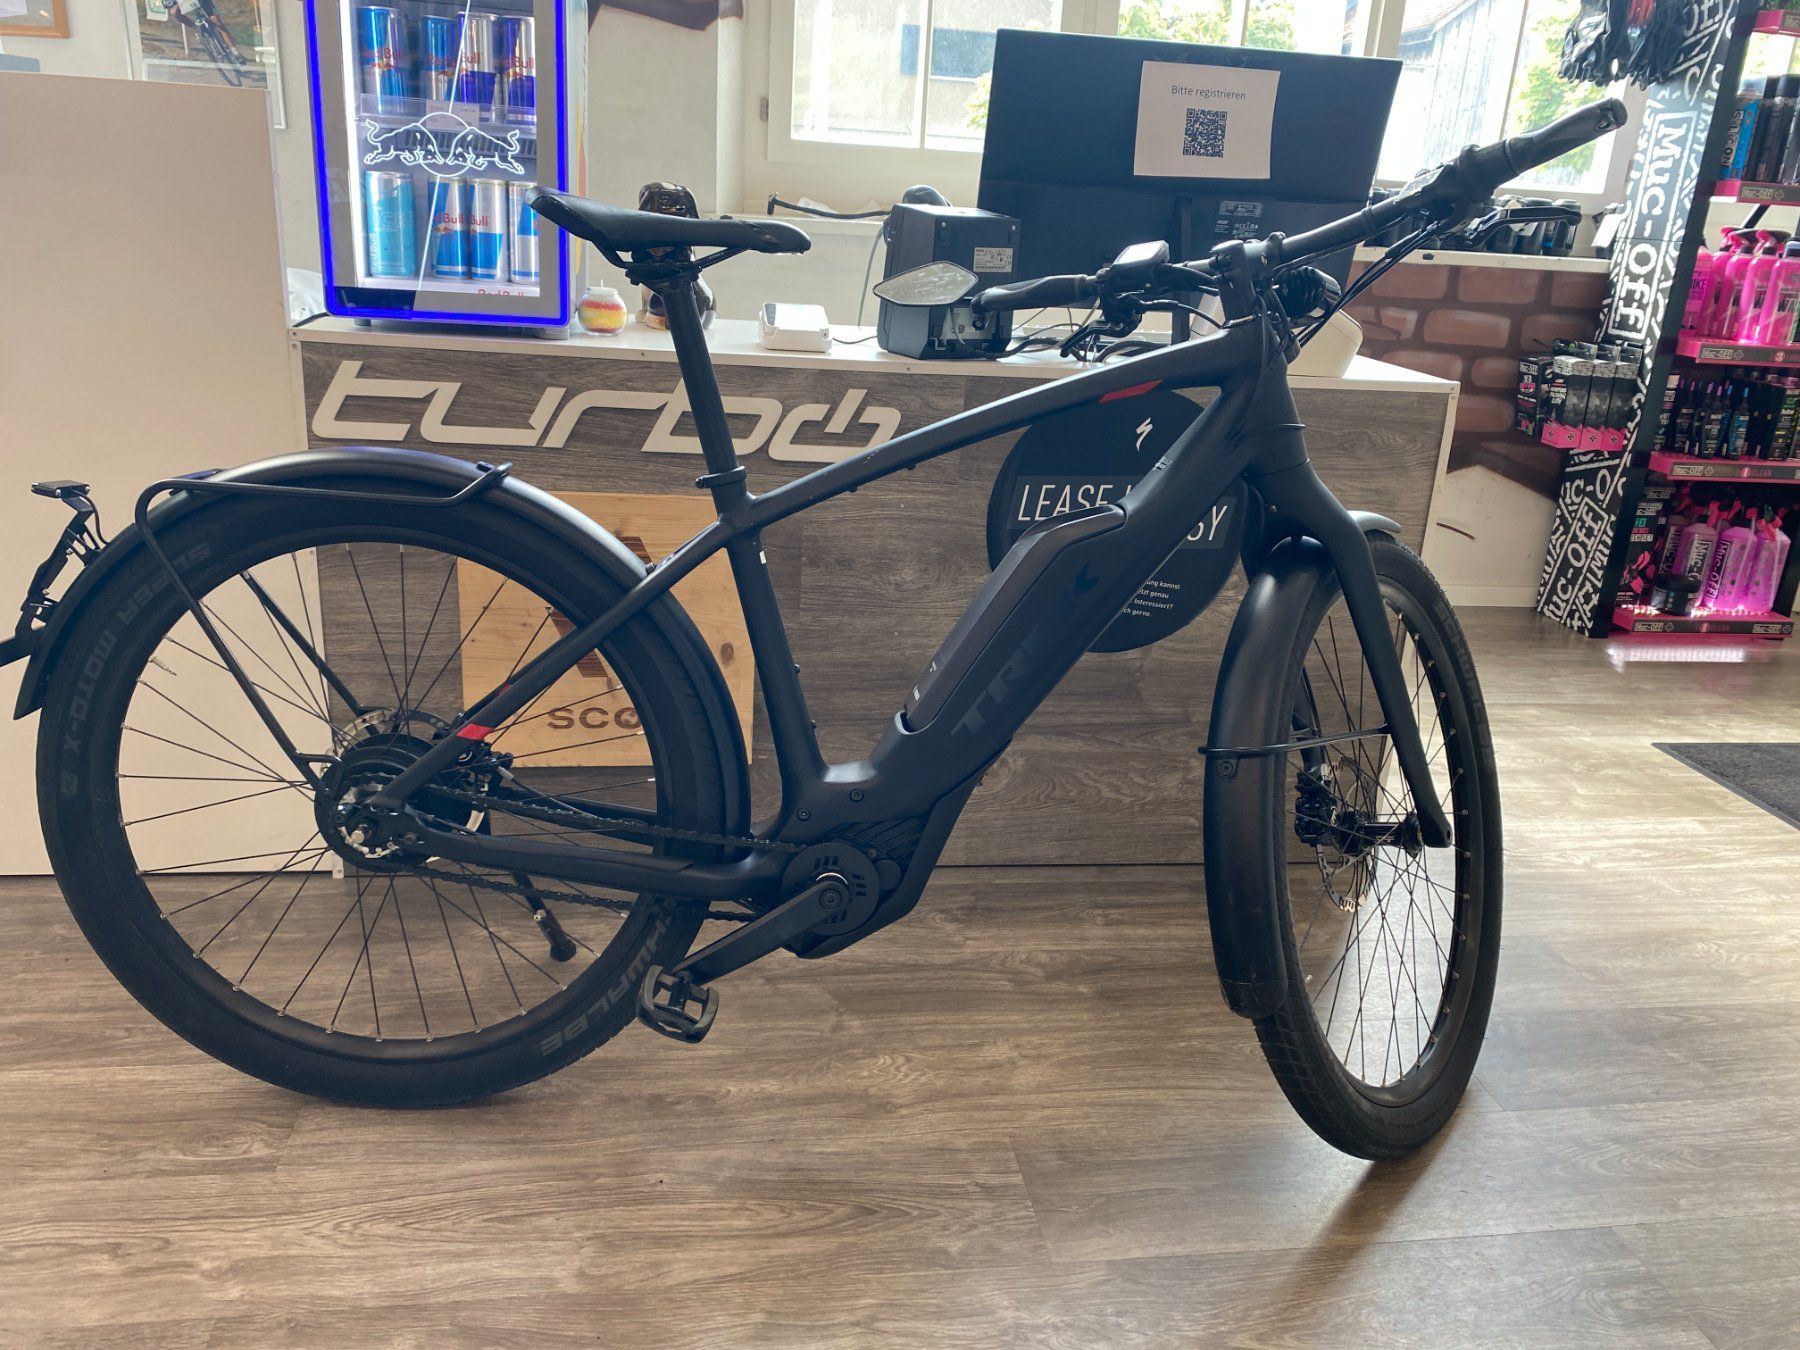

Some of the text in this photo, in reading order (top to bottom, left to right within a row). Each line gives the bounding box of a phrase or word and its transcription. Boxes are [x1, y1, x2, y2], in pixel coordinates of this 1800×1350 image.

[1171, 85, 1246, 101] Bitte registrieren
[312, 360, 902, 463] turbo
[1018, 484, 1113, 521] LEASE
[1159, 580, 1181, 590] kannst
[1132, 609, 1152, 618] gerne.
